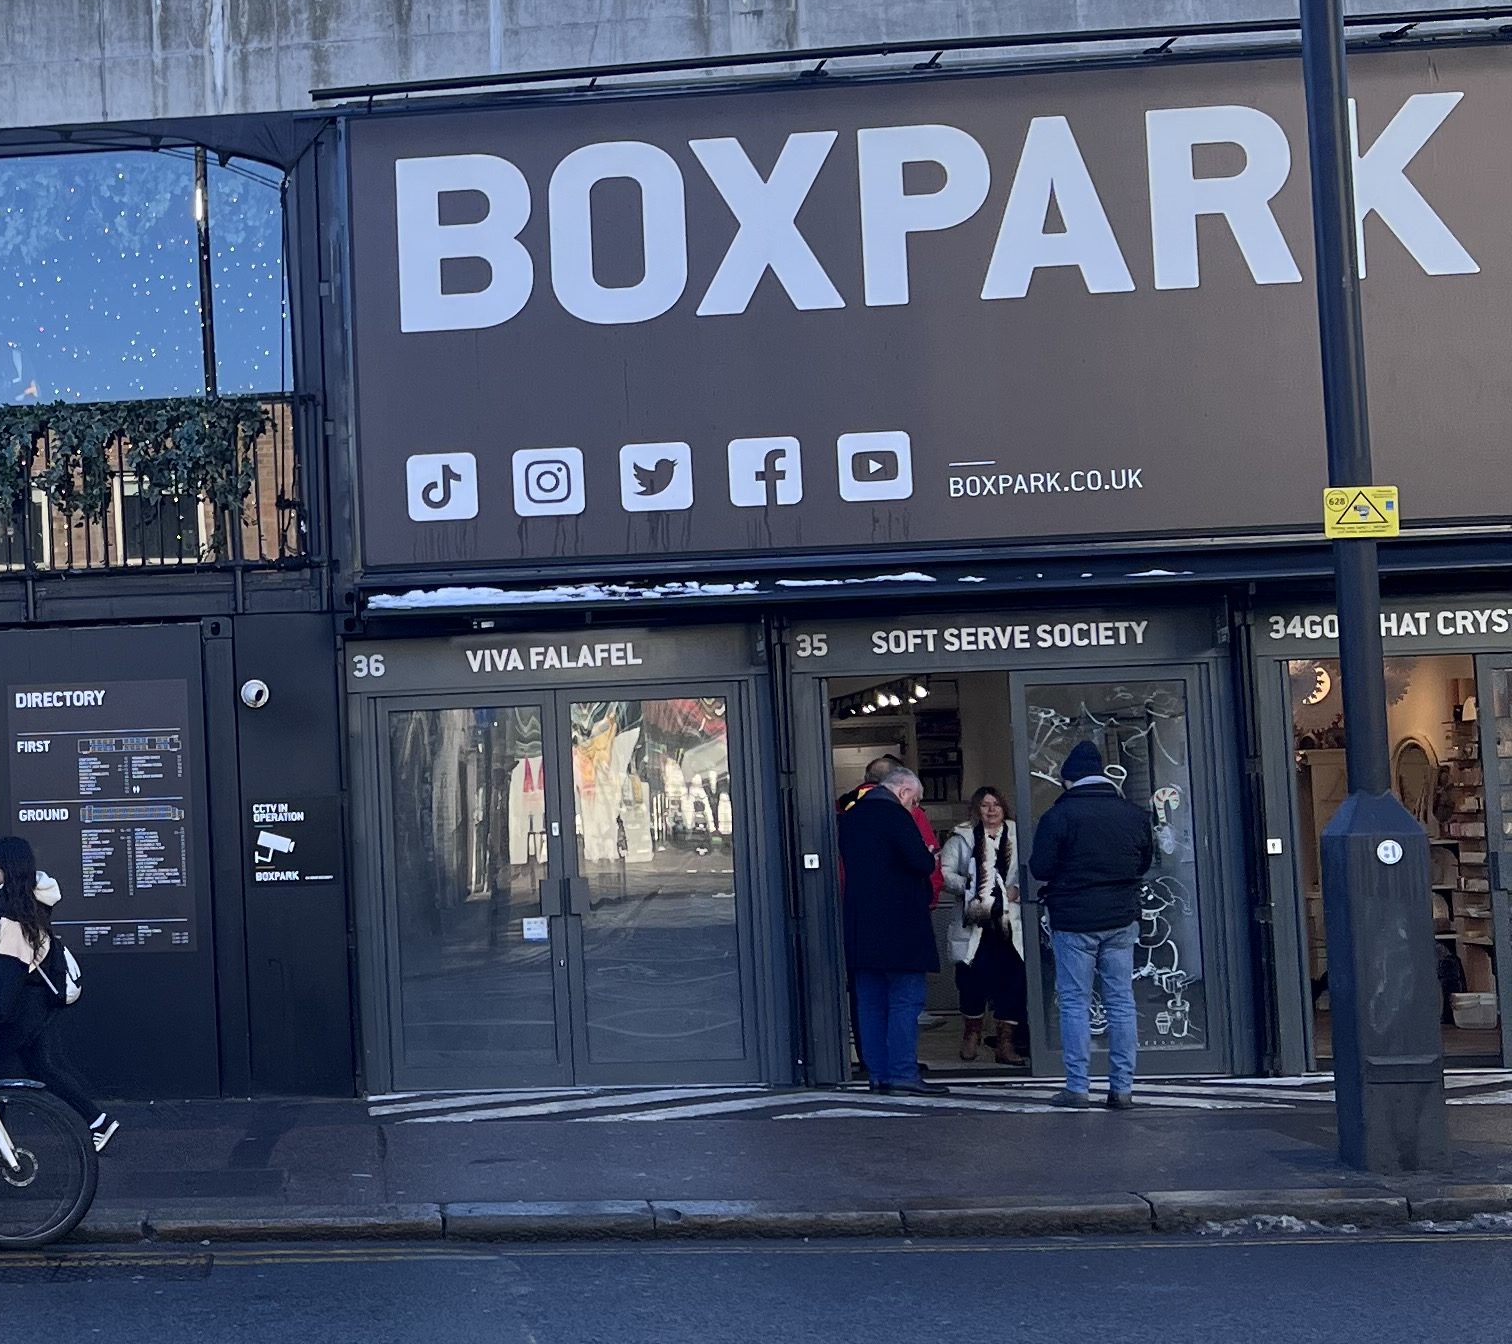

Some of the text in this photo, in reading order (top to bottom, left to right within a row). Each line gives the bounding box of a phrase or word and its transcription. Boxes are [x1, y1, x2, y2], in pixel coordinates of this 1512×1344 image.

[395, 91, 1481, 333] BOXPARK
[949, 468, 1143, 497] BOXPARK.CO.UK
[1379, 612, 1431, 637] HAT
[796, 633, 828, 657] 35
[871, 620, 1149, 655] SOFT SERVE SOCIETY
[352, 654, 386, 678] 36
[466, 642, 643, 673] VIVA FALAFEL
[15, 689, 106, 709] DIRECTORY
[17, 740, 51, 753] FIRST
[19, 808, 69, 822] GROUND
[253, 803, 288, 813] CCTV IN
[253, 812, 305, 822] OPERATION
[255, 871, 300, 882] BOXPARK
